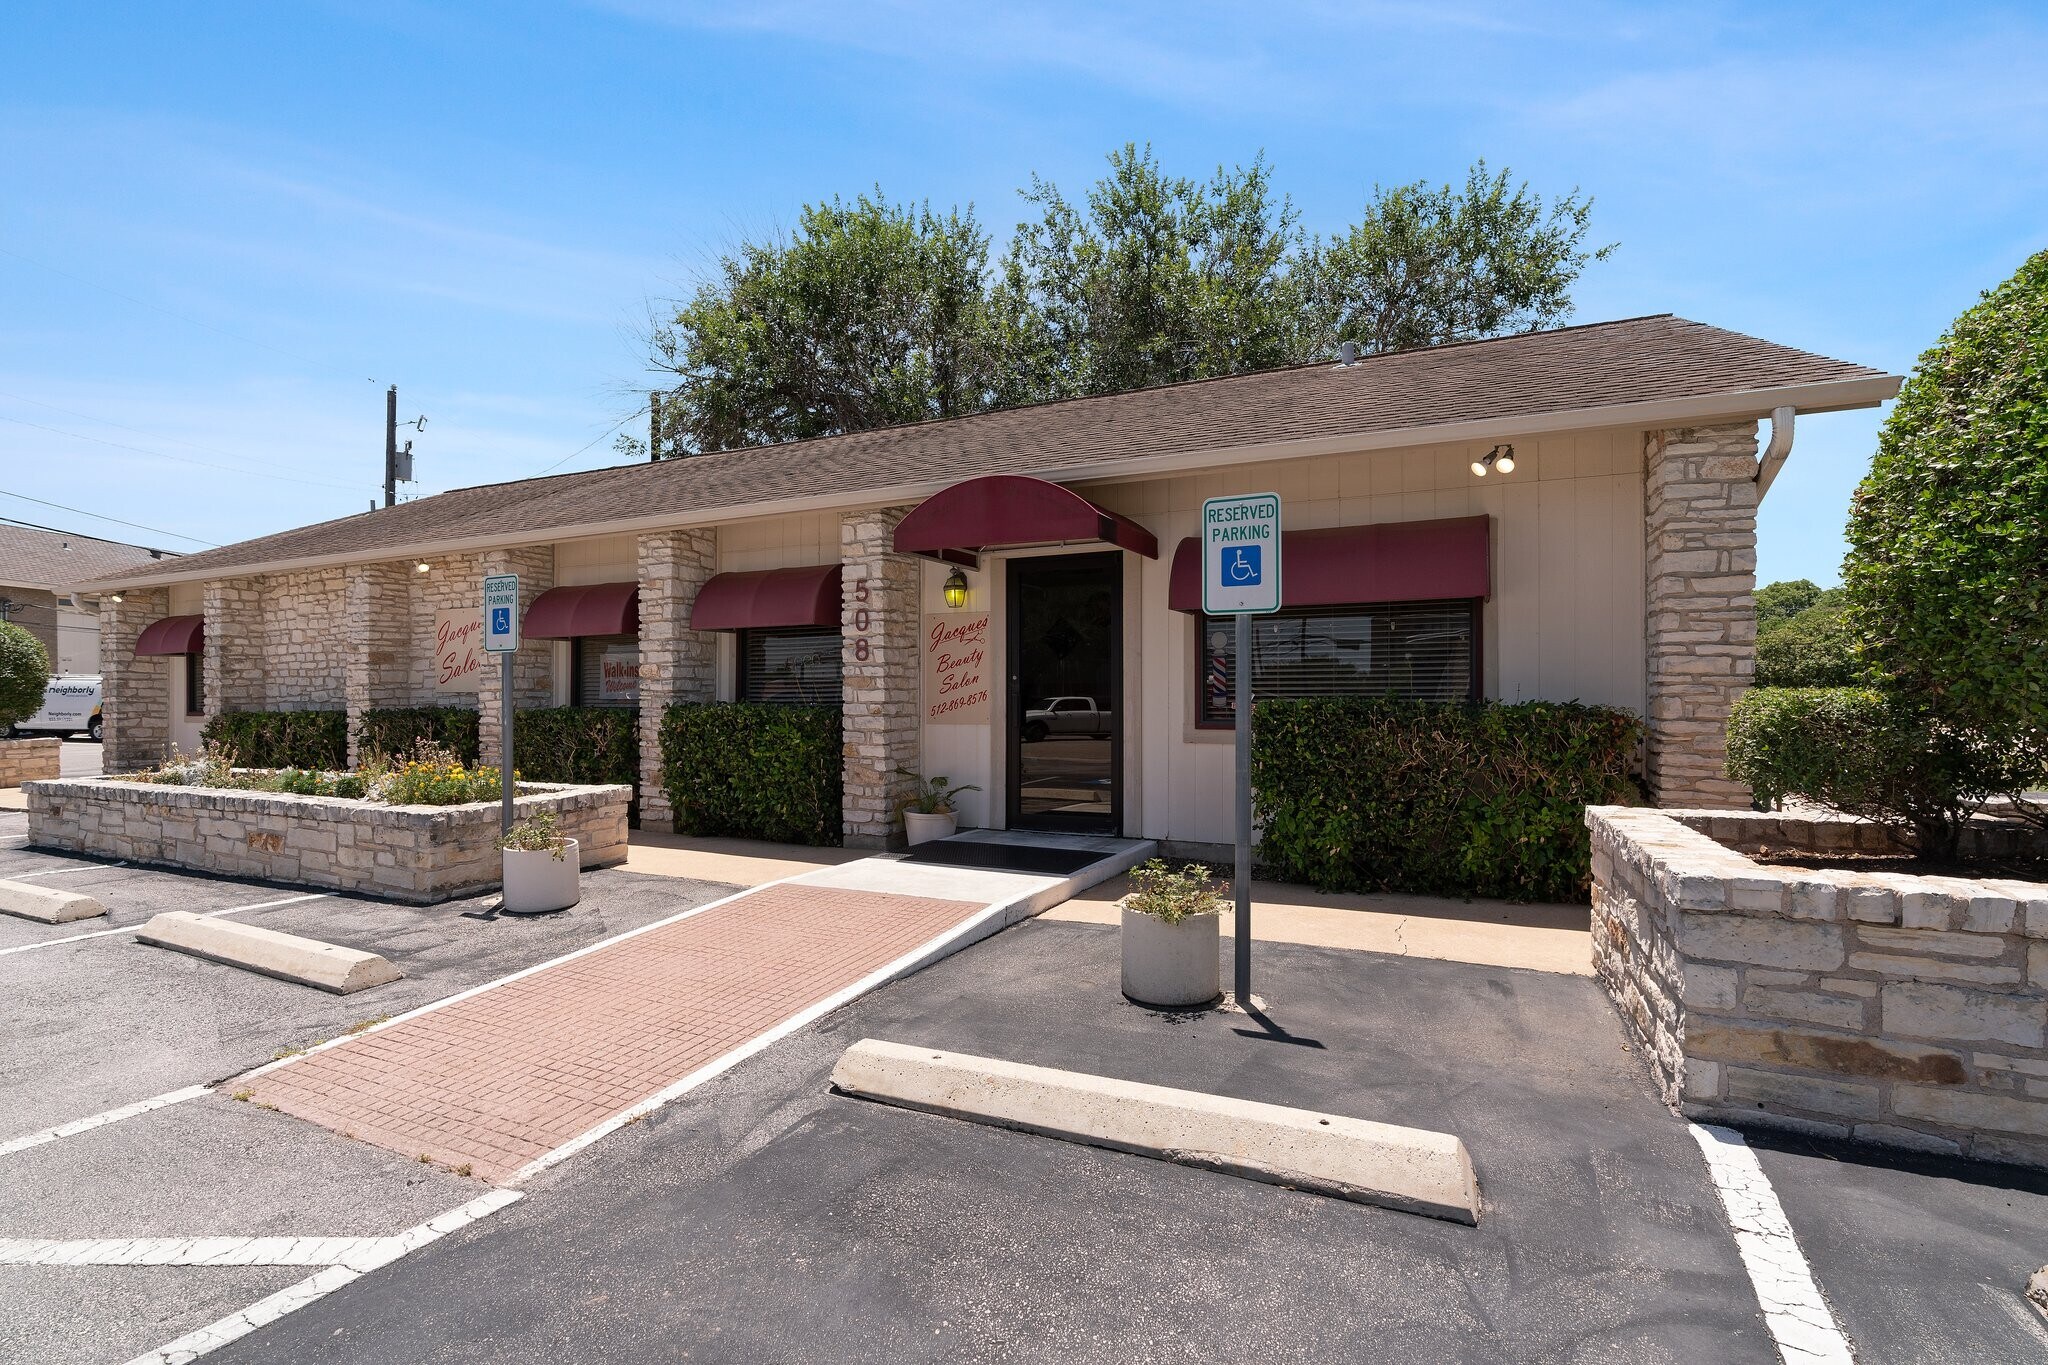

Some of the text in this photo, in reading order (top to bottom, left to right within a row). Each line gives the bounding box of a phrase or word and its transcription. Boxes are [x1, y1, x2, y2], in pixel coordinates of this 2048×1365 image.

[1208, 503, 1275, 523] RESERVED
[1212, 524, 1270, 542] PARKING
[486, 580, 516, 593] RESERVED
[488, 594, 514, 605] PARKING
[855, 578, 869, 662] 508
[436, 620, 481, 656] Jacque
[929, 617, 988, 653] Jacques
[603, 661, 640, 679] Walk-ins
[936, 648, 984, 673] Beauty
[48, 685, 95, 696] neighborly
[940, 671, 979, 694] Salon
[930, 690, 988, 717] 512-869-8576
